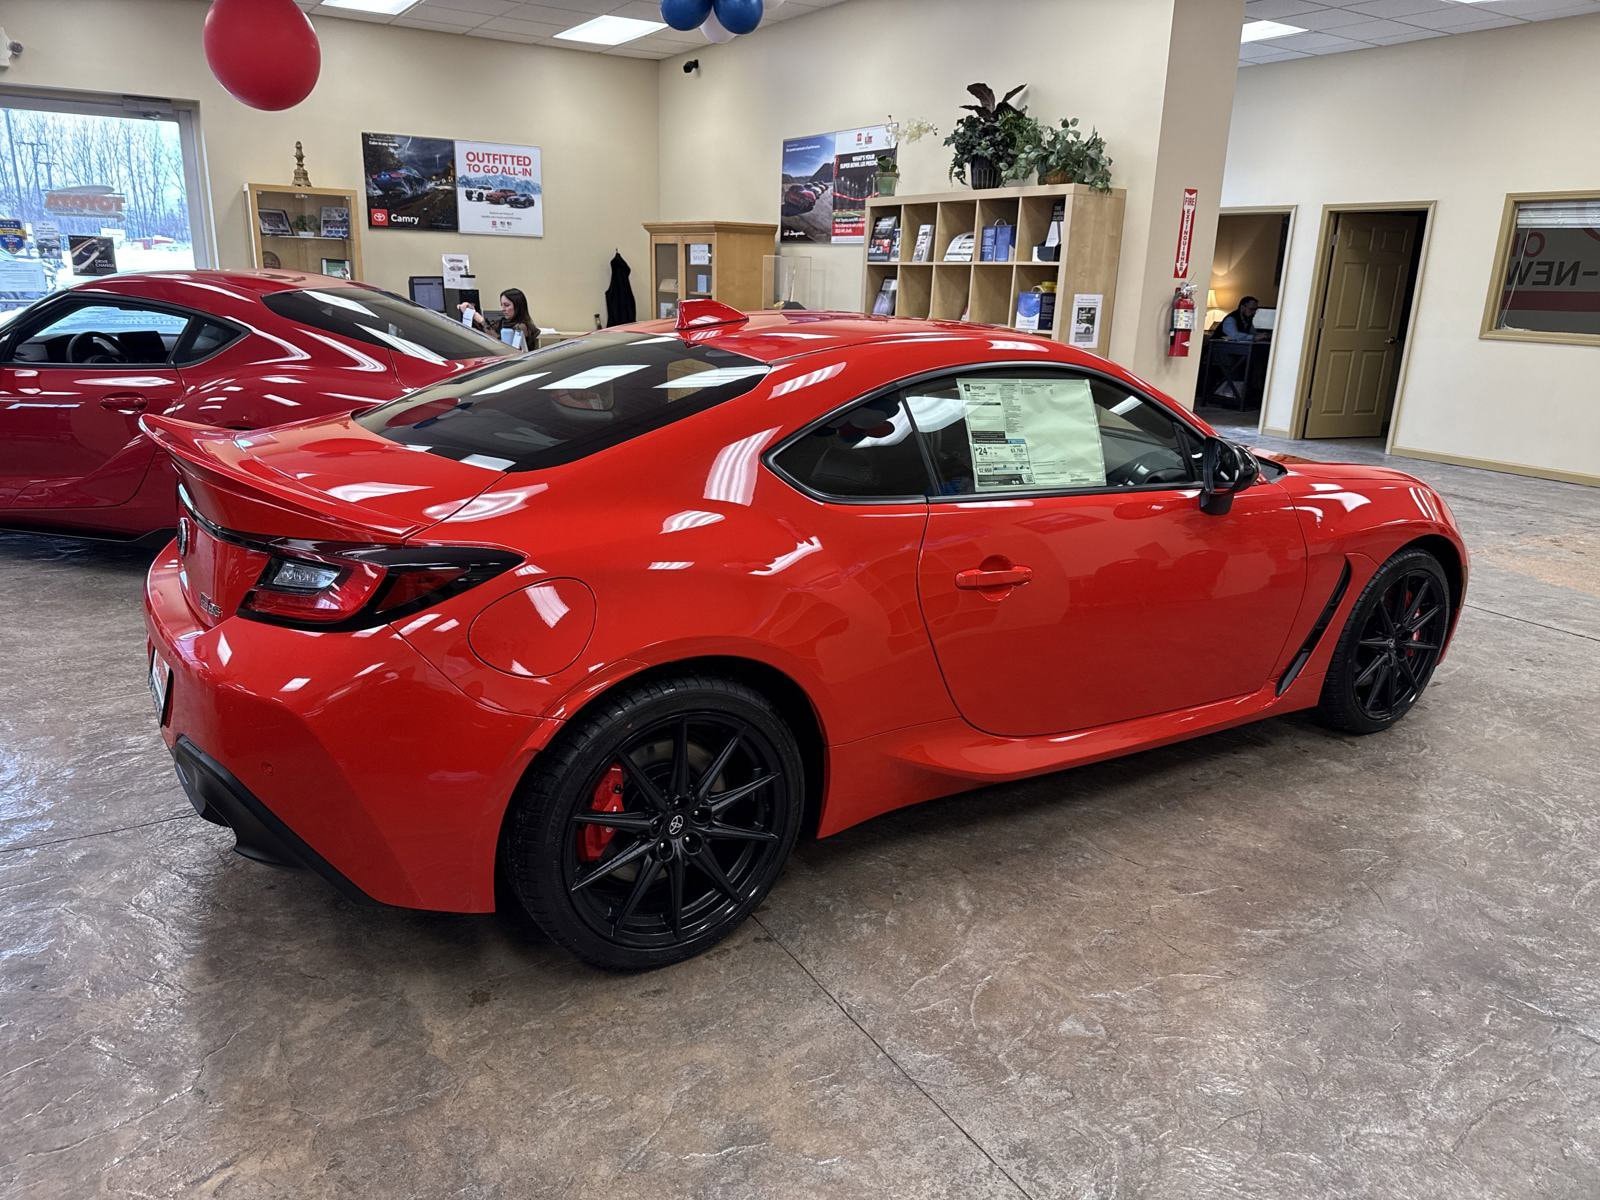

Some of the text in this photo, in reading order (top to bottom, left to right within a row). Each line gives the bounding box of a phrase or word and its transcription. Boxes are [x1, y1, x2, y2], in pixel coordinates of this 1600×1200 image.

[466, 151, 532, 166] OUTFITTED
[466, 163, 532, 177] TO GO ALL-IN
[390, 213, 420, 225] Camry
[1179, 208, 1191, 271] EXTINGUISHER
[978, 447, 988, 456] 24
